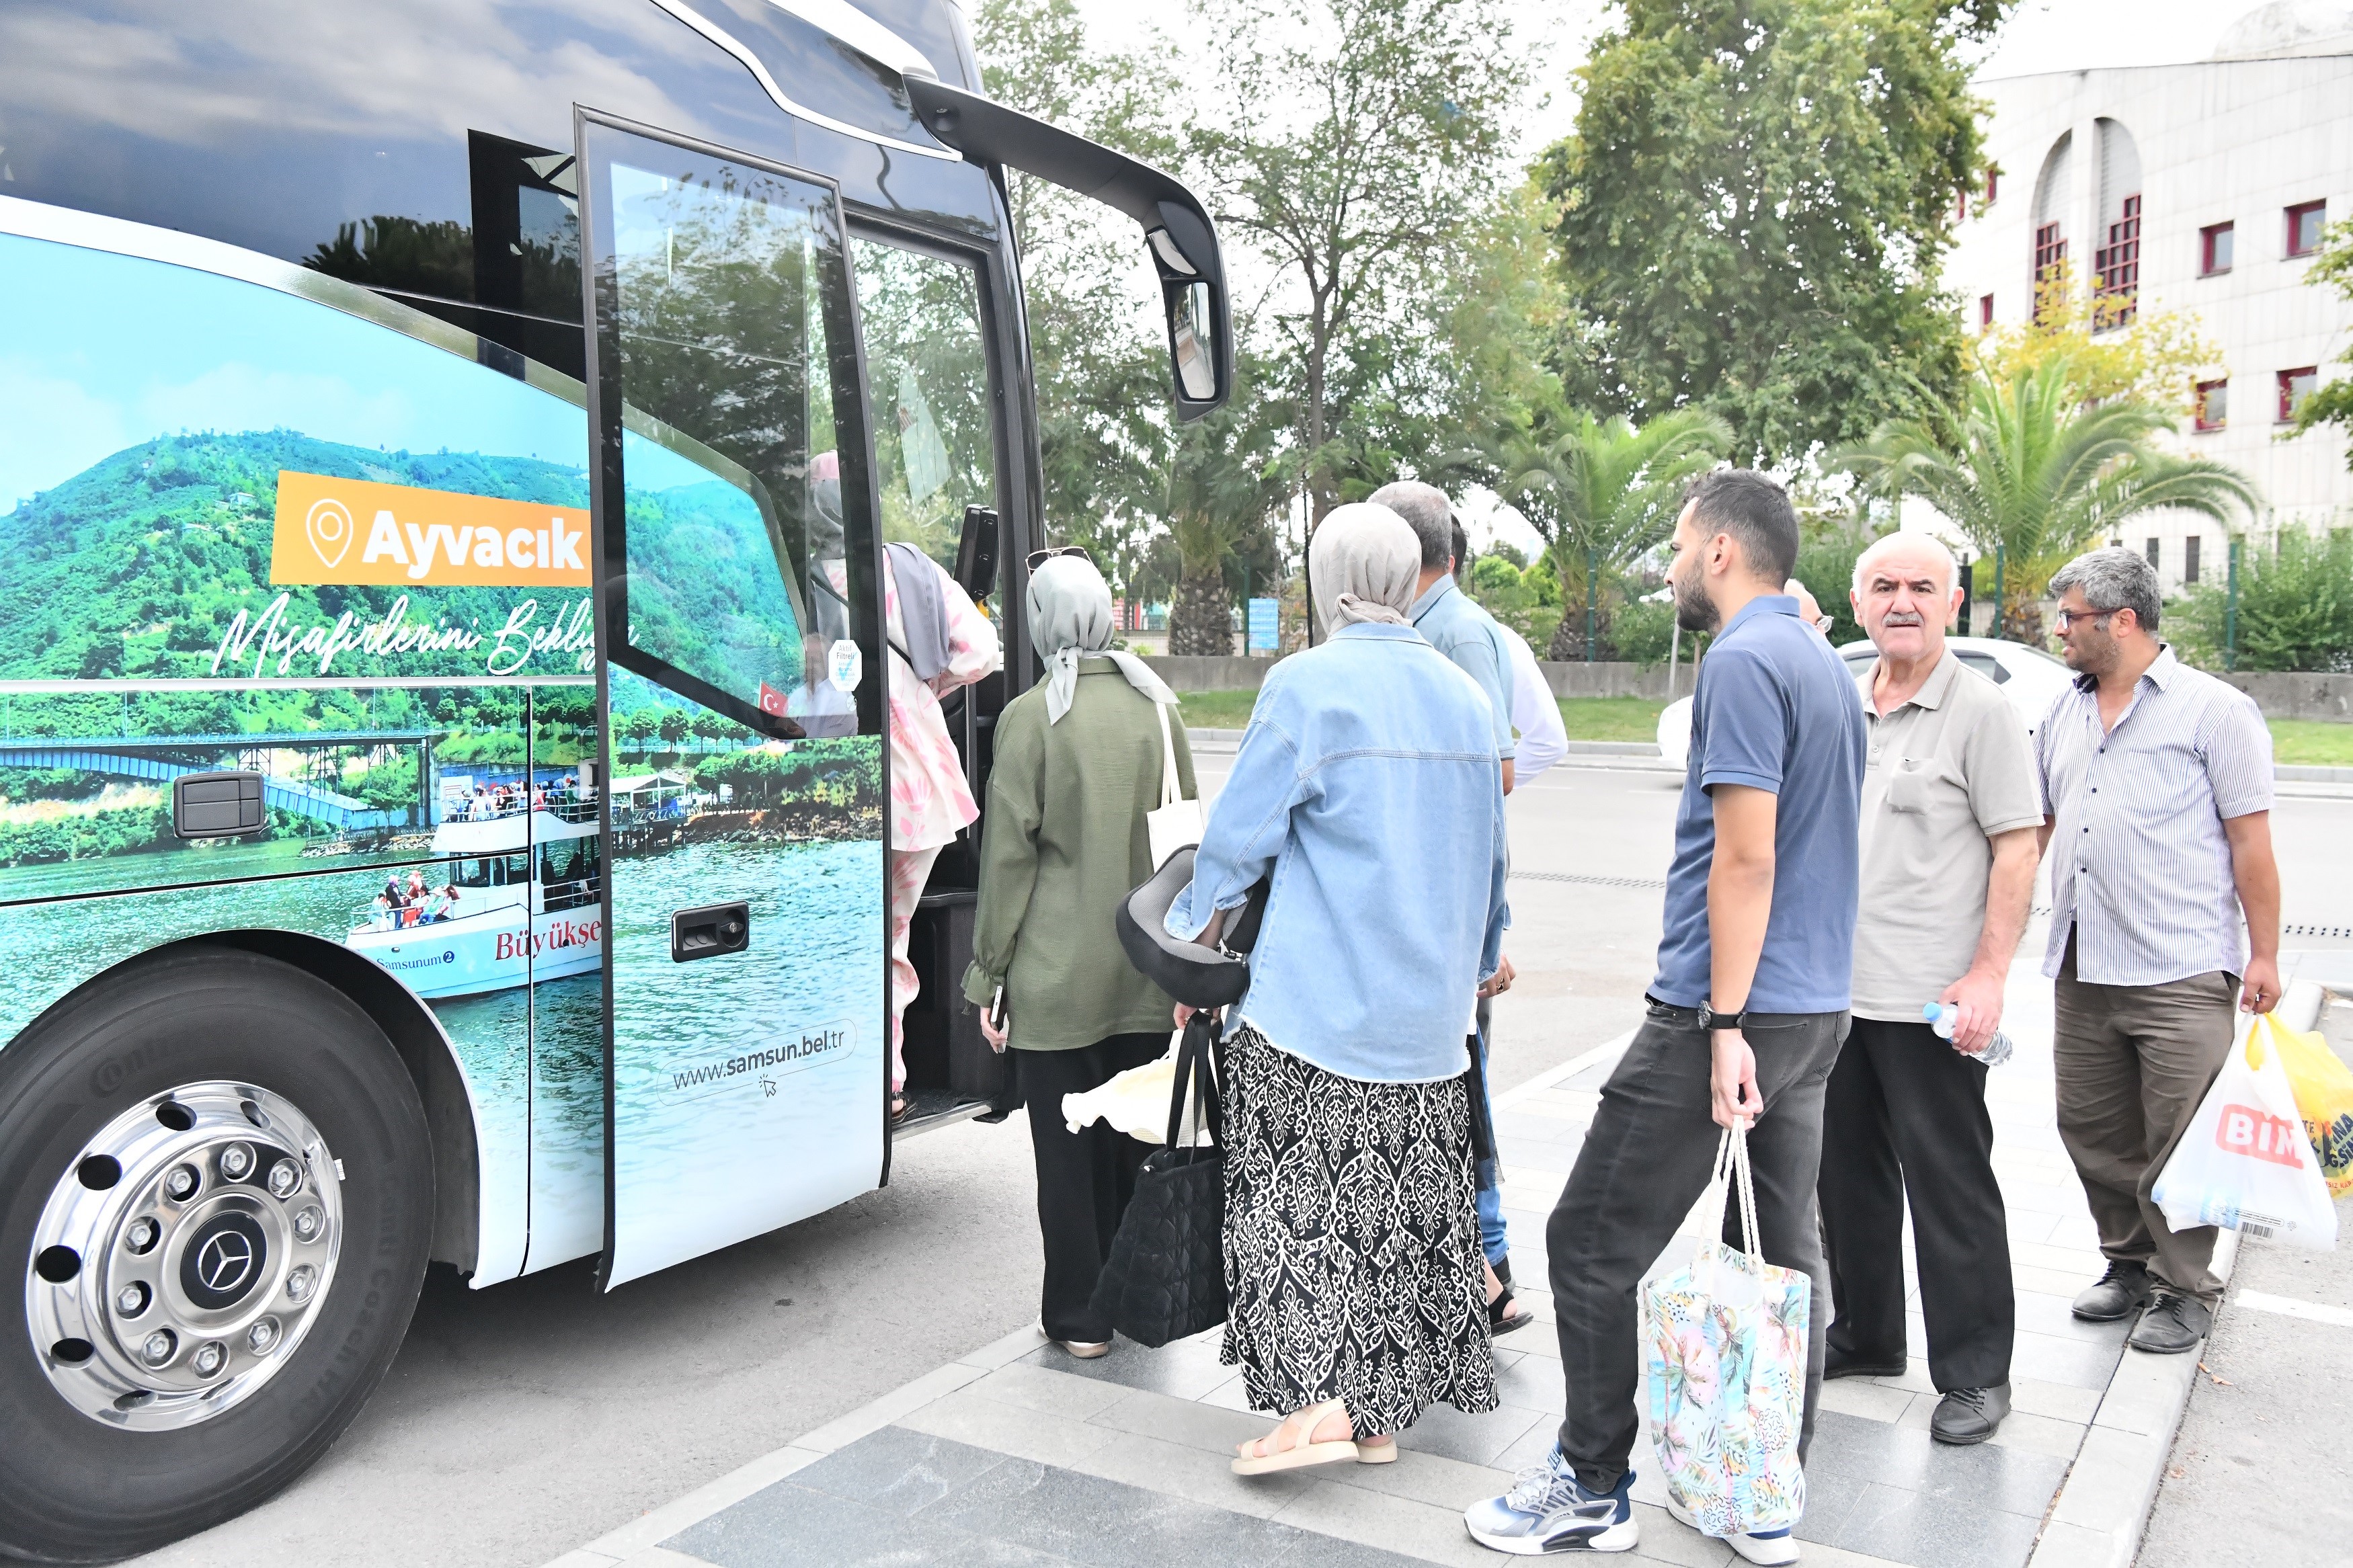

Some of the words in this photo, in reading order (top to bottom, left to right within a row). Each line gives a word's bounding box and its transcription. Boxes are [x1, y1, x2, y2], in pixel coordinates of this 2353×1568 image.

[362, 510, 585, 579] Ayvacık
[376, 956, 442, 970] Samsunum
[674, 1030, 844, 1089] www.samsun.bel.tr
[335, 1268, 393, 1365] Coach
